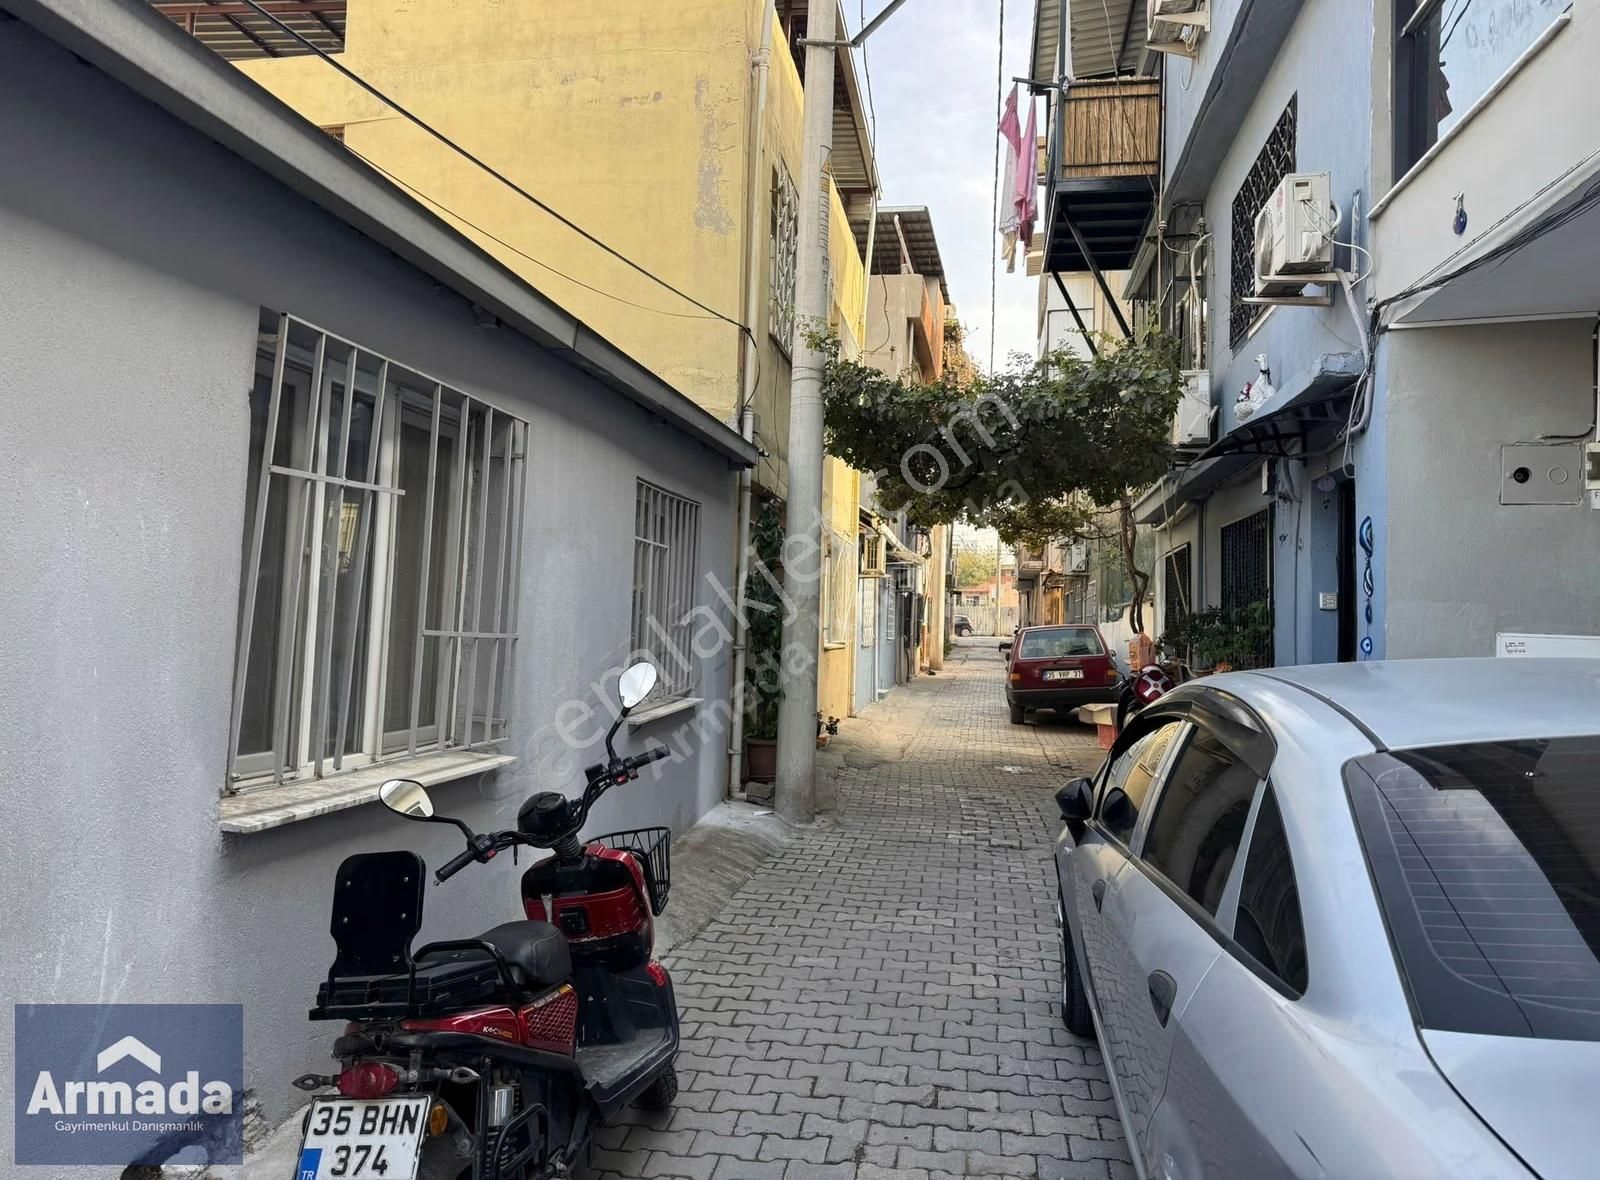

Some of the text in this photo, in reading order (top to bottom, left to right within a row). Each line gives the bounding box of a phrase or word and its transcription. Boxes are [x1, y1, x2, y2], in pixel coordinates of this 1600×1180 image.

[313, 1104, 421, 1135] 35 BHN
[302, 1170, 314, 1180] TR
[331, 1144, 388, 1176] 374
